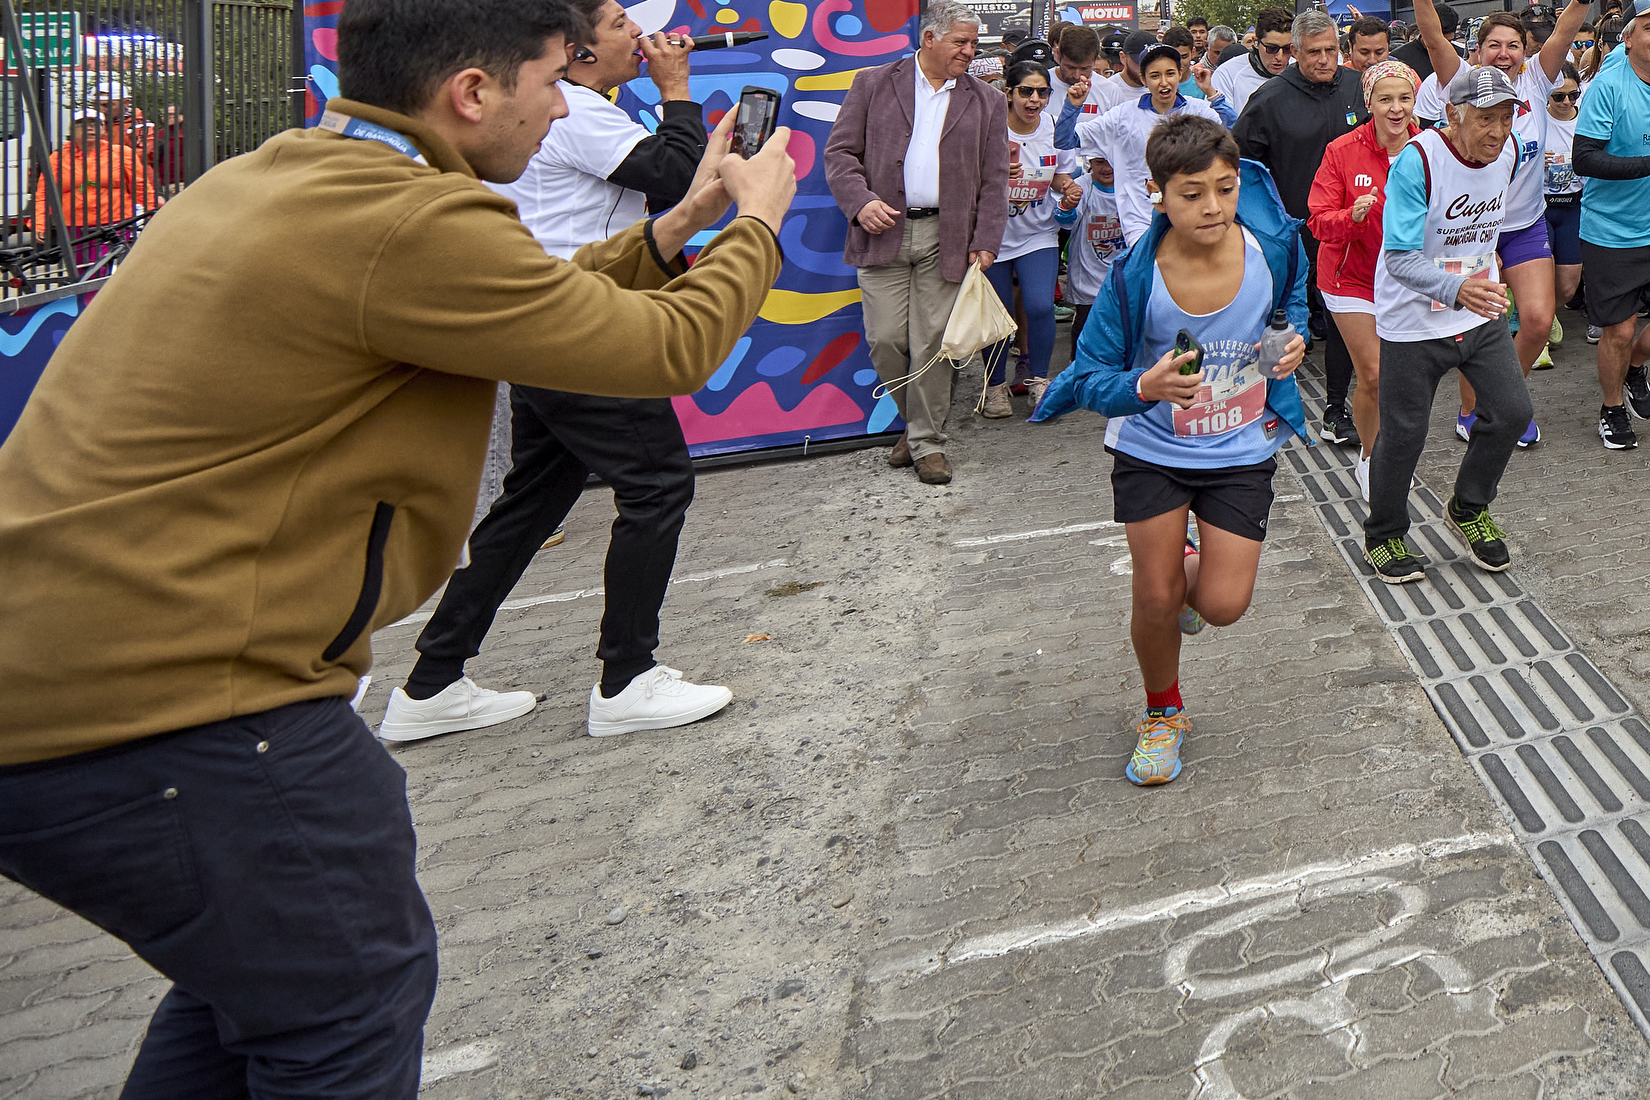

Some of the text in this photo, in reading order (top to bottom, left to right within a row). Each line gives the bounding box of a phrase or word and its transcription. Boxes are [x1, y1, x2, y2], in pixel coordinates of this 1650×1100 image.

[966, 3, 1017, 11] PUESTOS
[1082, 7, 1130, 19] MOTUL
[353, 128, 365, 137] DE
[365, 131, 408, 153] RANCAGUA
[1201, 339, 1255, 354] NNIVERSARY
[1203, 358, 1241, 383] TAR
[1205, 401, 1227, 414] 2.5K
[1186, 406, 1243, 435] 1108
